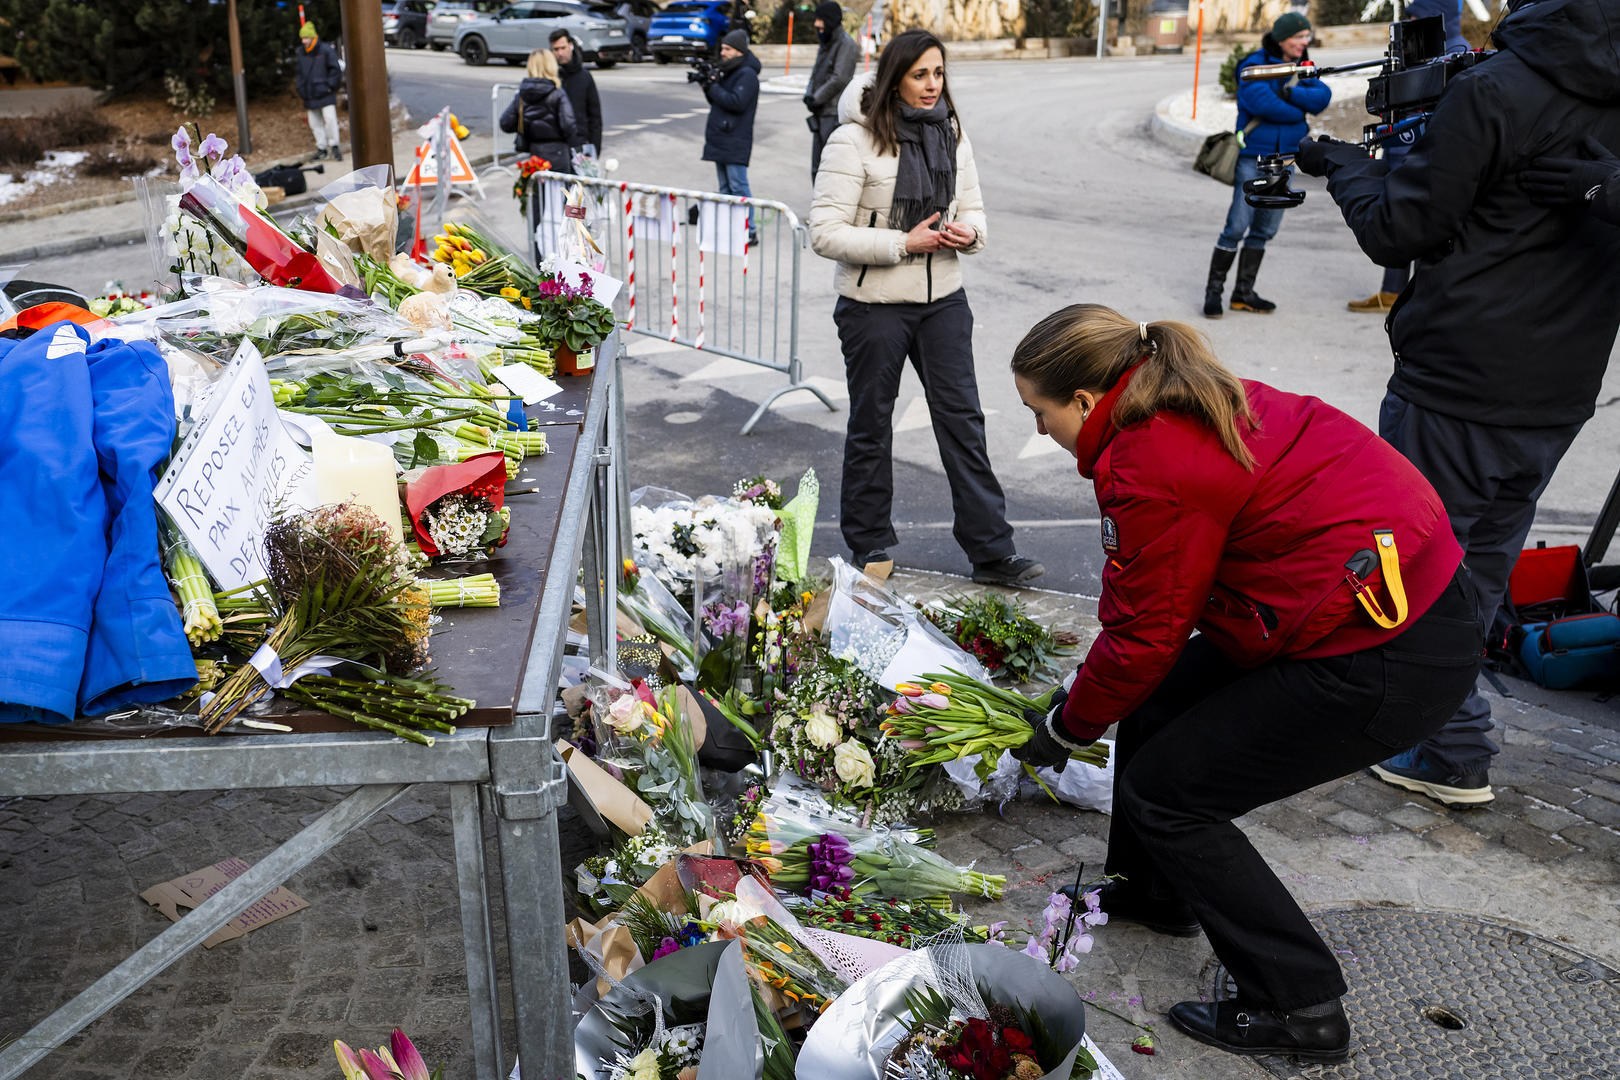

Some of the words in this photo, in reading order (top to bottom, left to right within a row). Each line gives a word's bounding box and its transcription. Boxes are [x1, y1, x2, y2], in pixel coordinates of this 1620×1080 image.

[176, 414, 245, 530] REPOSEZ
[241, 376, 256, 409] EN
[229, 531, 254, 582] DES
